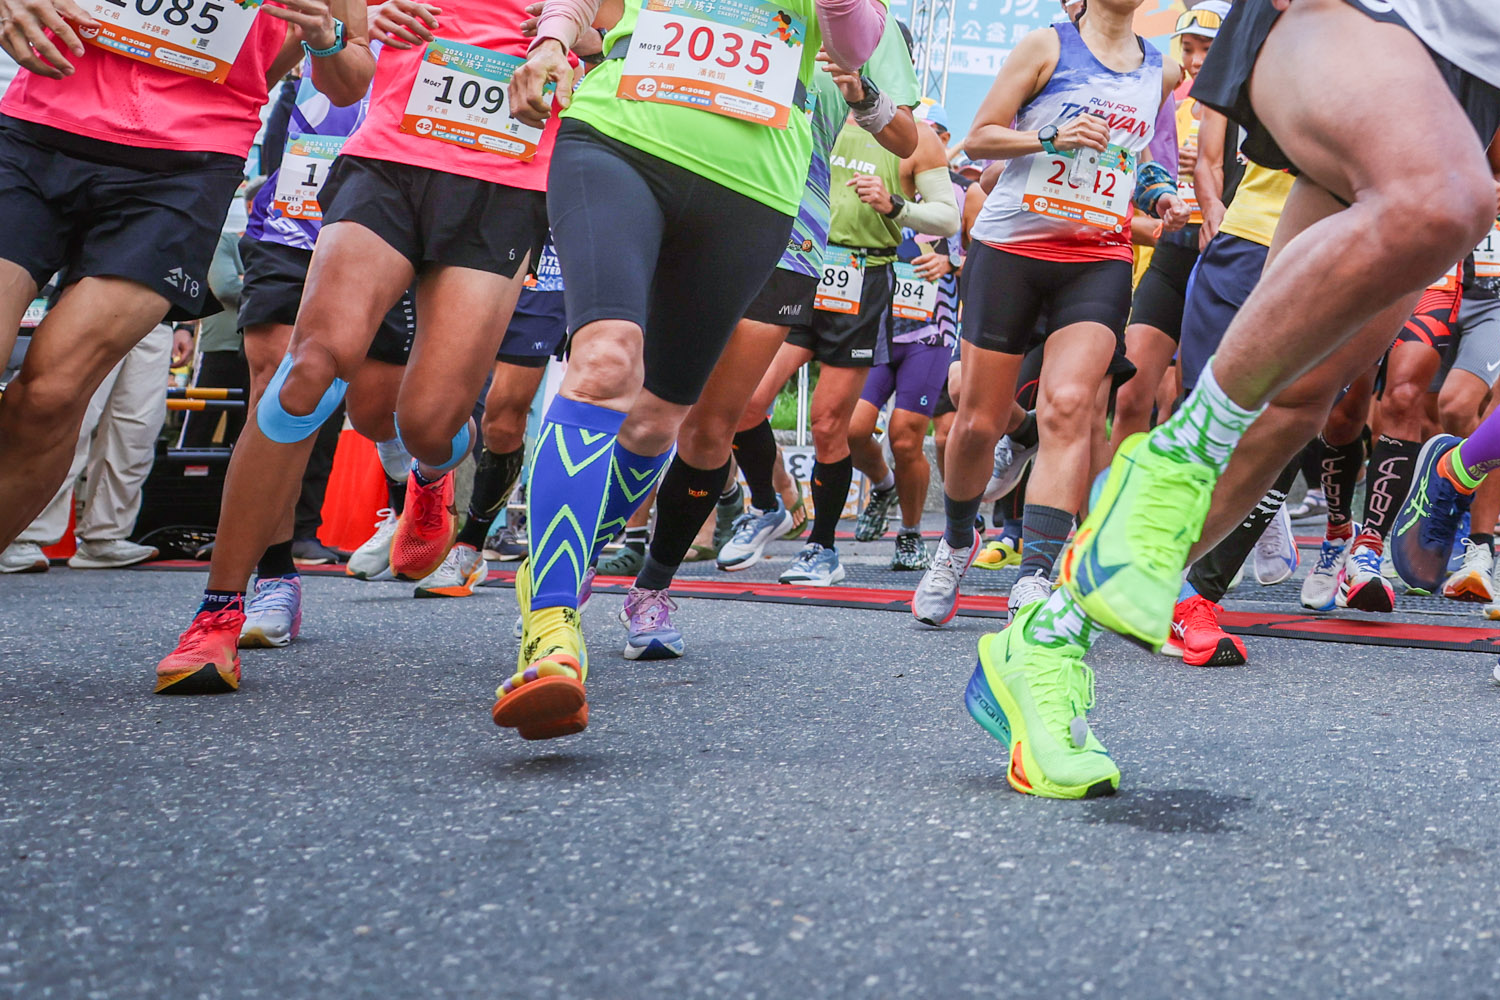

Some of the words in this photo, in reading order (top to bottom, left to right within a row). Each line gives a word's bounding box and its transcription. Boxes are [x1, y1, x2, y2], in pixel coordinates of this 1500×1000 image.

[102, 28, 116, 38] km
[639, 42, 661, 52] M019
[656, 22, 772, 75] 2035
[423, 78, 442, 88] M047
[637, 84, 655, 93] 42
[660, 82, 675, 91] km
[434, 75, 506, 115] 109
[1089, 97, 1114, 108] RUN
[1116, 103, 1137, 114] FOR
[417, 122, 431, 131] 42
[435, 123, 447, 131] km
[183, 273, 200, 298] T8
